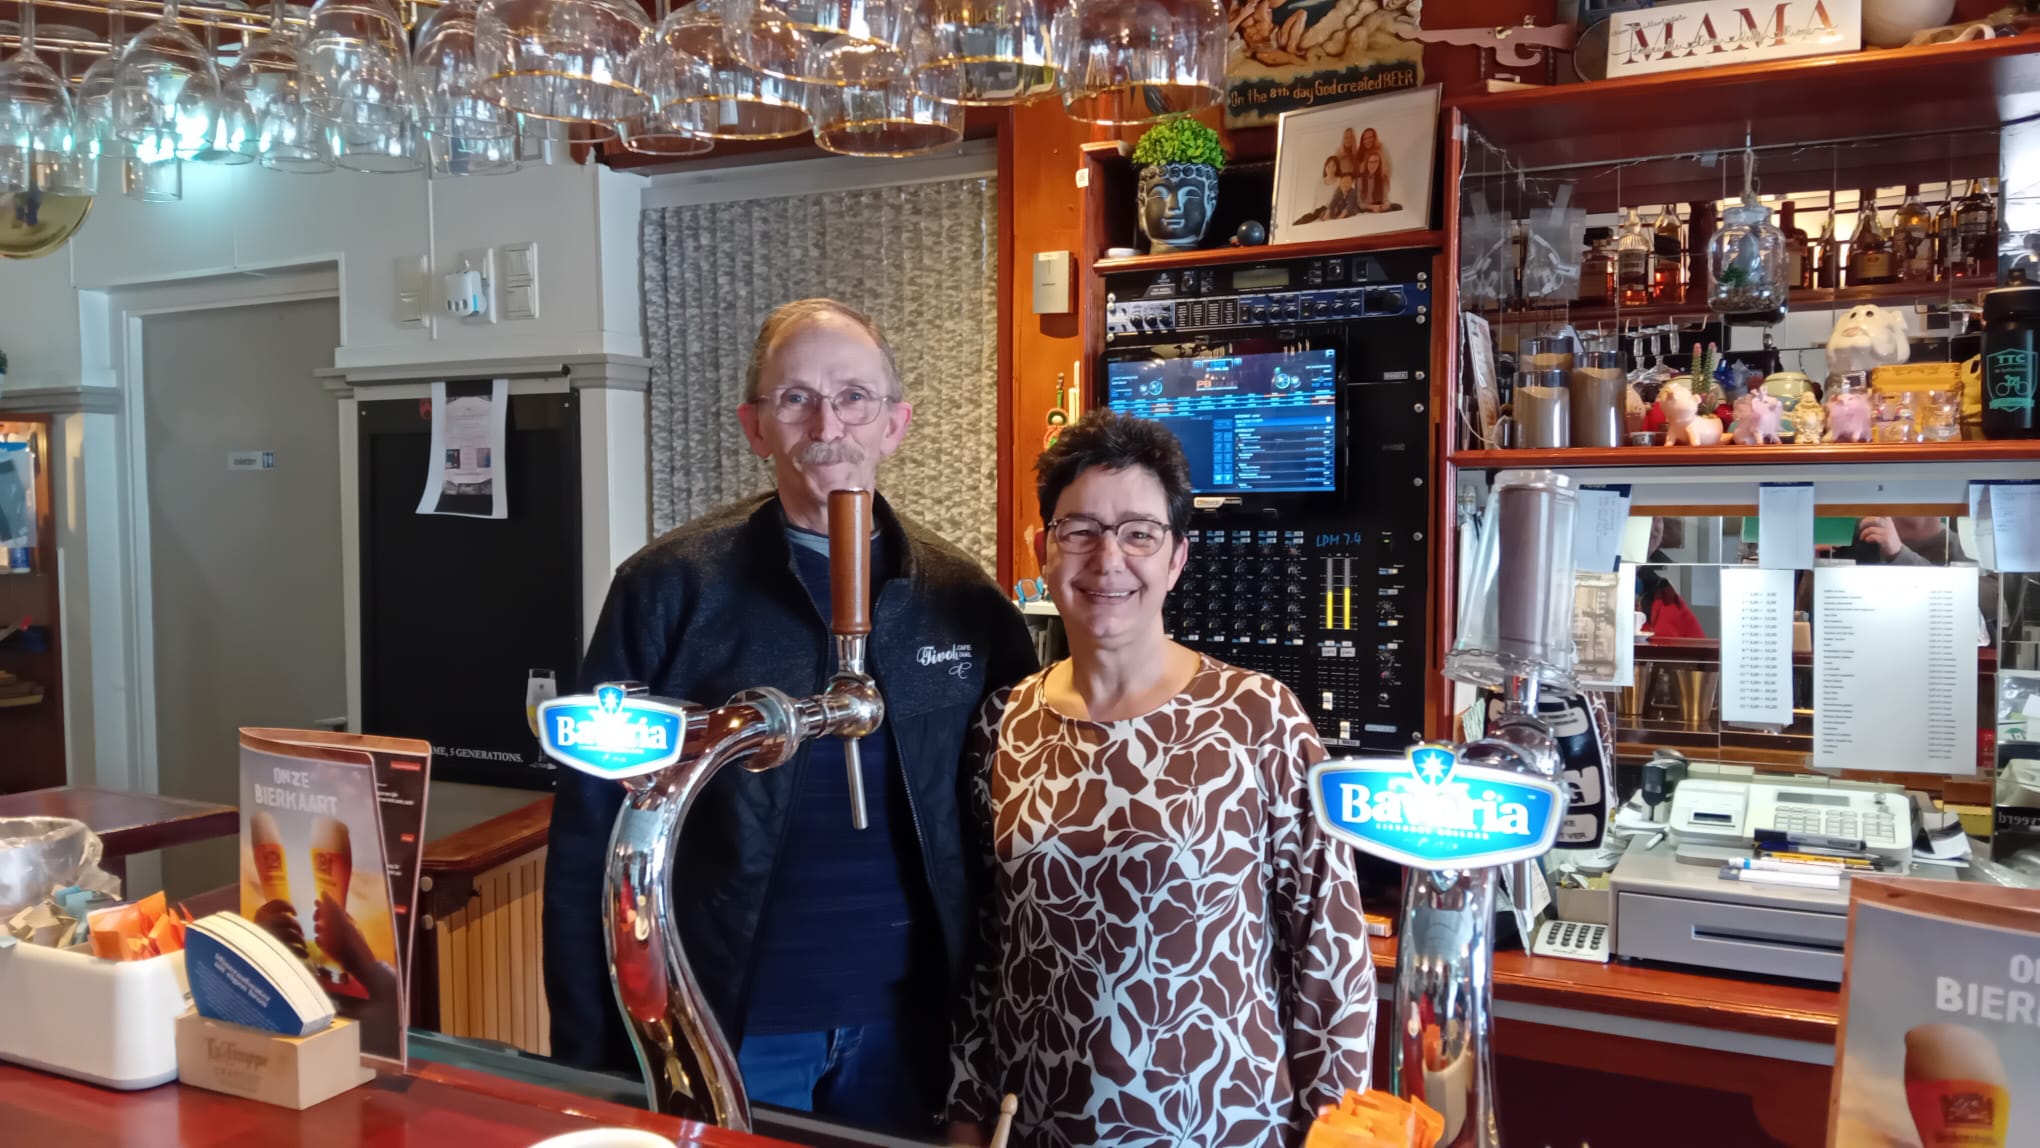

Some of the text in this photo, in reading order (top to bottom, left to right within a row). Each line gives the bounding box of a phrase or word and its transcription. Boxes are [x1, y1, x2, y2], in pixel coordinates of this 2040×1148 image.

[1622, 0, 1842, 64] MAMA
[1231, 90, 1244, 107] On
[1292, 86, 1314, 104] day
[1314, 79, 1337, 97] God
[1337, 74, 1382, 94] created
[1381, 69, 1414, 88] BEER
[1997, 354, 2026, 364] TTC
[1343, 532, 1362, 544] 7.4
[916, 643, 959, 667] Tivoli
[431, 745, 524, 763] ME, 5 GENERATIONS.
[273, 767, 311, 789] ONZE
[254, 783, 338, 816] BIERKAART
[2009, 954, 2040, 984] O
[1936, 976, 2040, 1029] BIER
